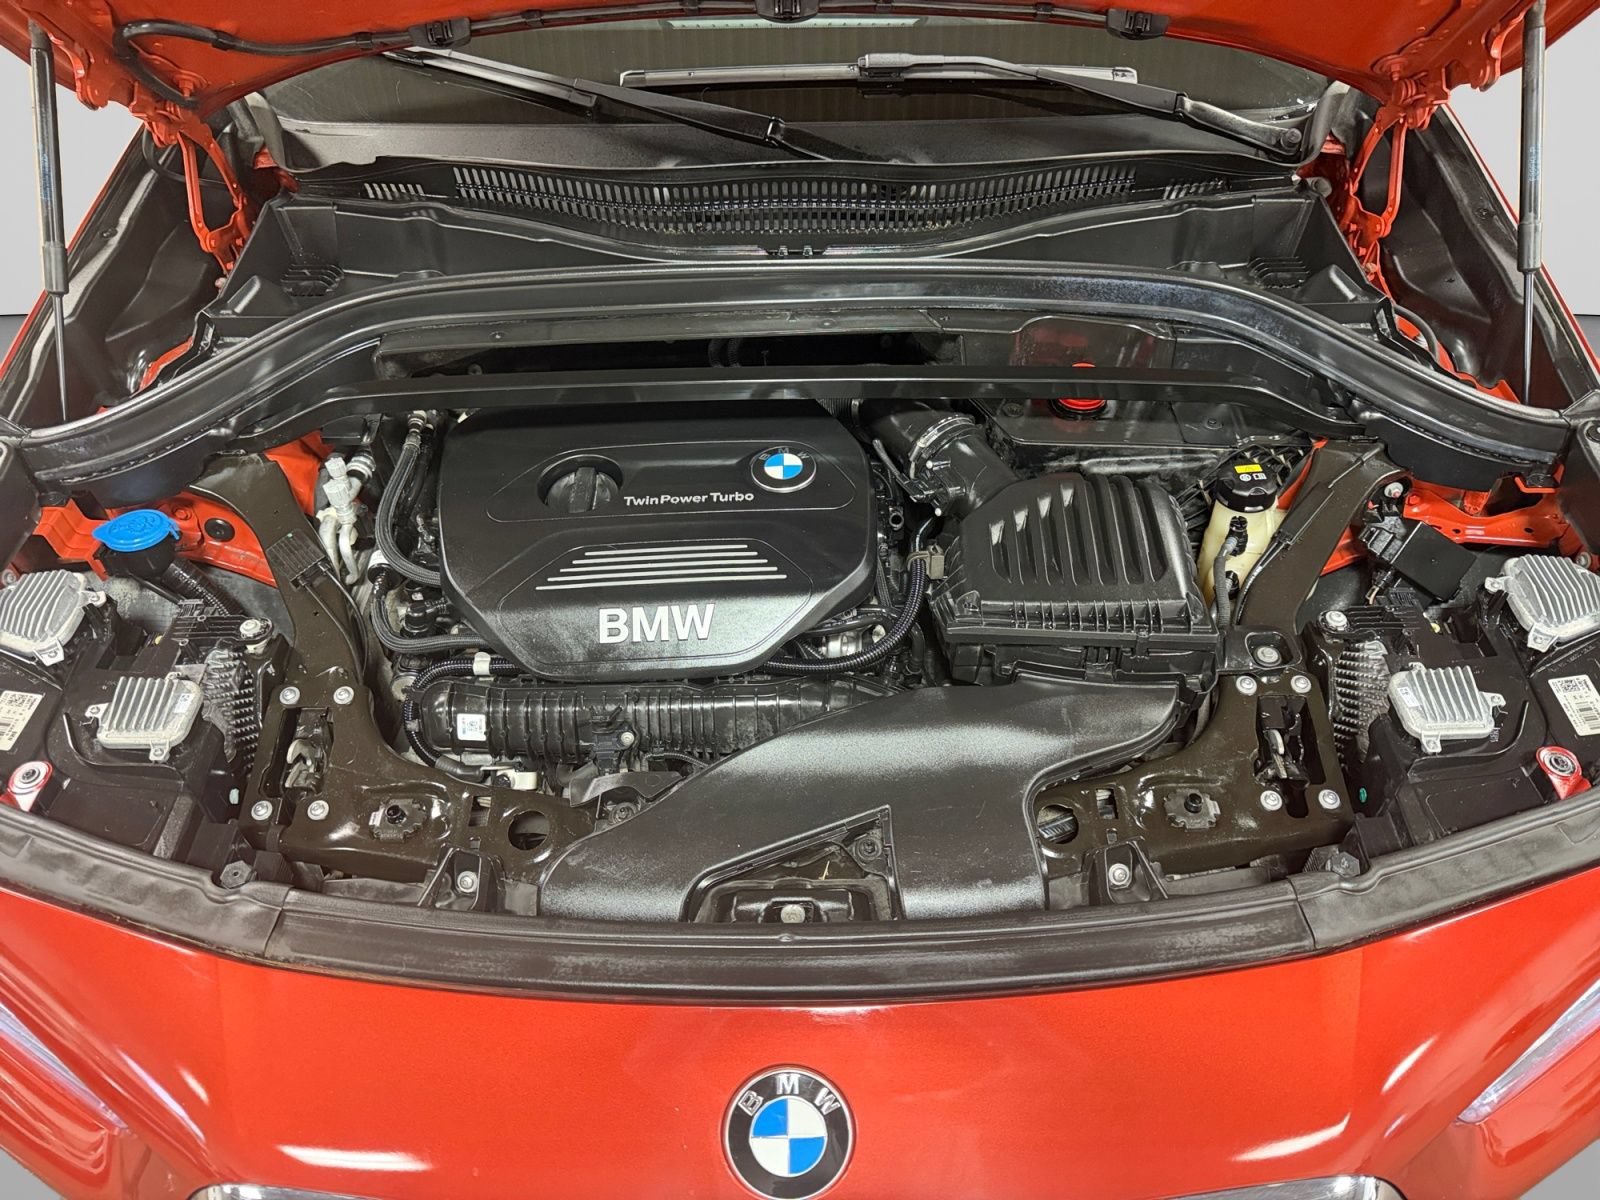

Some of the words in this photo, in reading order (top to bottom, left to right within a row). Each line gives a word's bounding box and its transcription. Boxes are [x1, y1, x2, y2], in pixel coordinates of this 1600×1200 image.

[759, 447, 810, 461] BMW
[709, 491, 755, 503] Turbo
[599, 603, 715, 644] BMW
[738, 1073, 841, 1117] BMW
